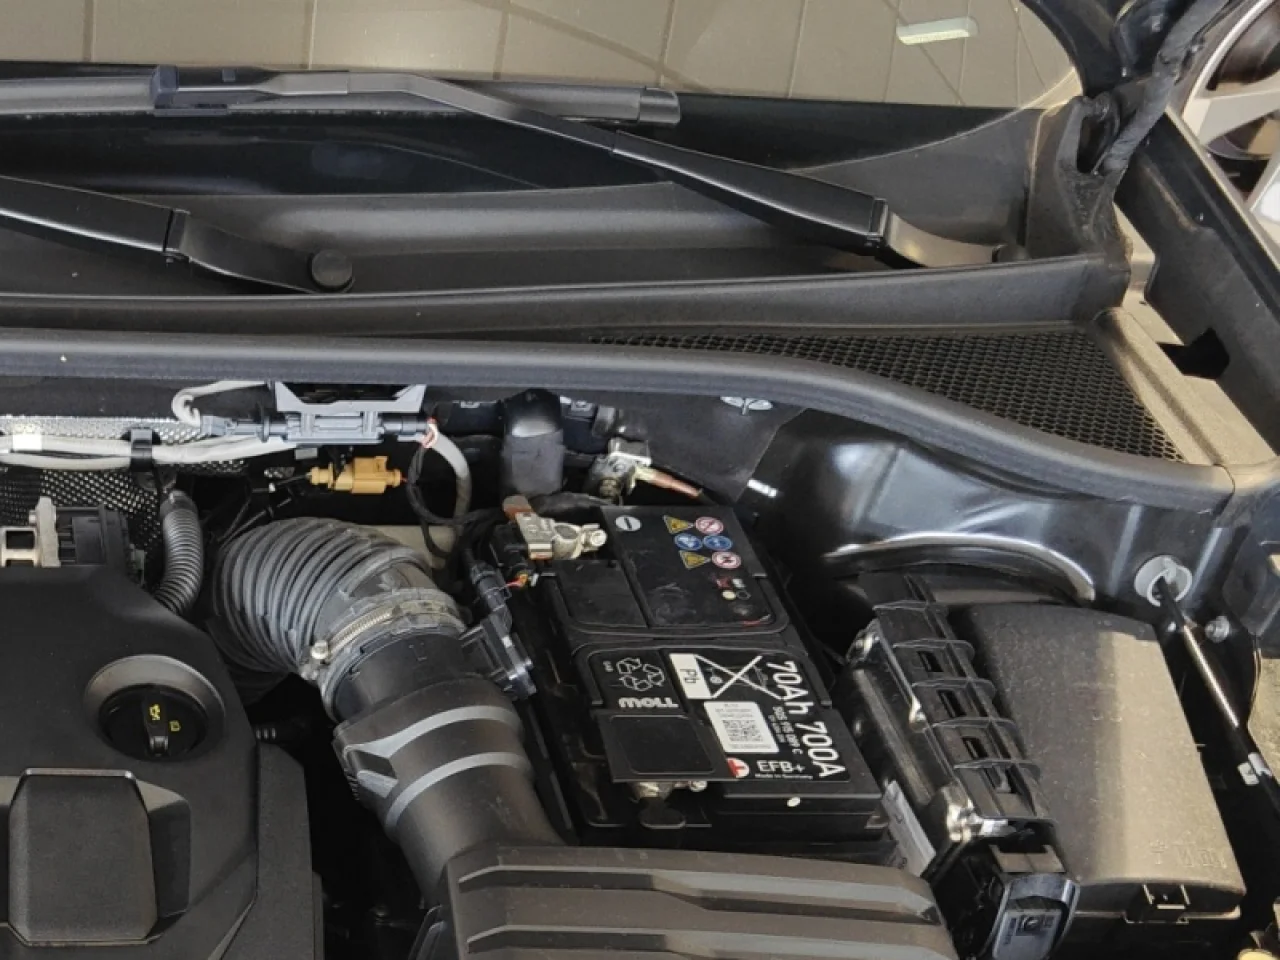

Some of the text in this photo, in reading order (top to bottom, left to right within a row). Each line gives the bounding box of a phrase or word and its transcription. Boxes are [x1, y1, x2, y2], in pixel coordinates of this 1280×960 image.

[678, 668, 699, 684] Pb
[766, 660, 816, 715] 70Ah
[795, 720, 847, 777] 700A
[757, 759, 805, 773] EFB+
